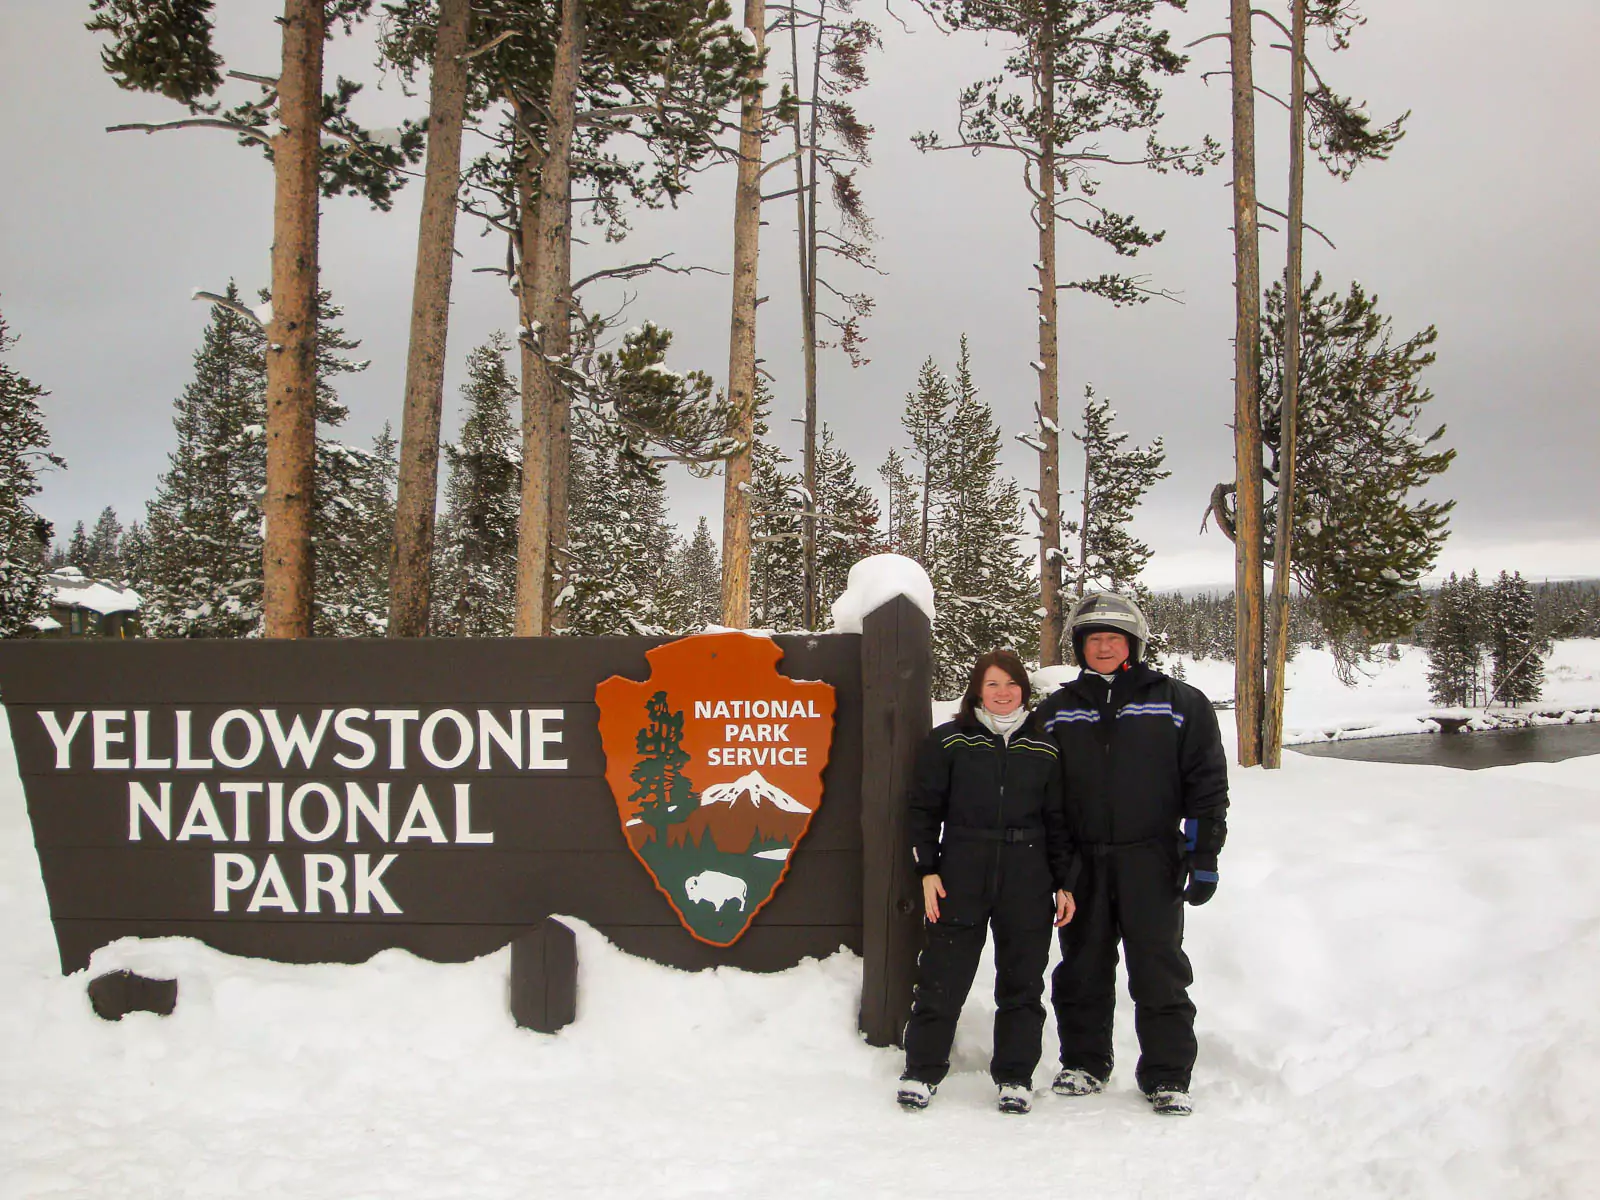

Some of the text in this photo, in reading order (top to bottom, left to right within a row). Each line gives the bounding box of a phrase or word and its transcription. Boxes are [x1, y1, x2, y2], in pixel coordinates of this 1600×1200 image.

[694, 700, 821, 719] NATIONAL
[37, 708, 569, 770] YELLOWSTONE
[725, 724, 790, 742] PARK
[707, 747, 808, 766] SERVICE
[128, 782, 494, 844] NATIONAL
[213, 853, 404, 914] PARK
